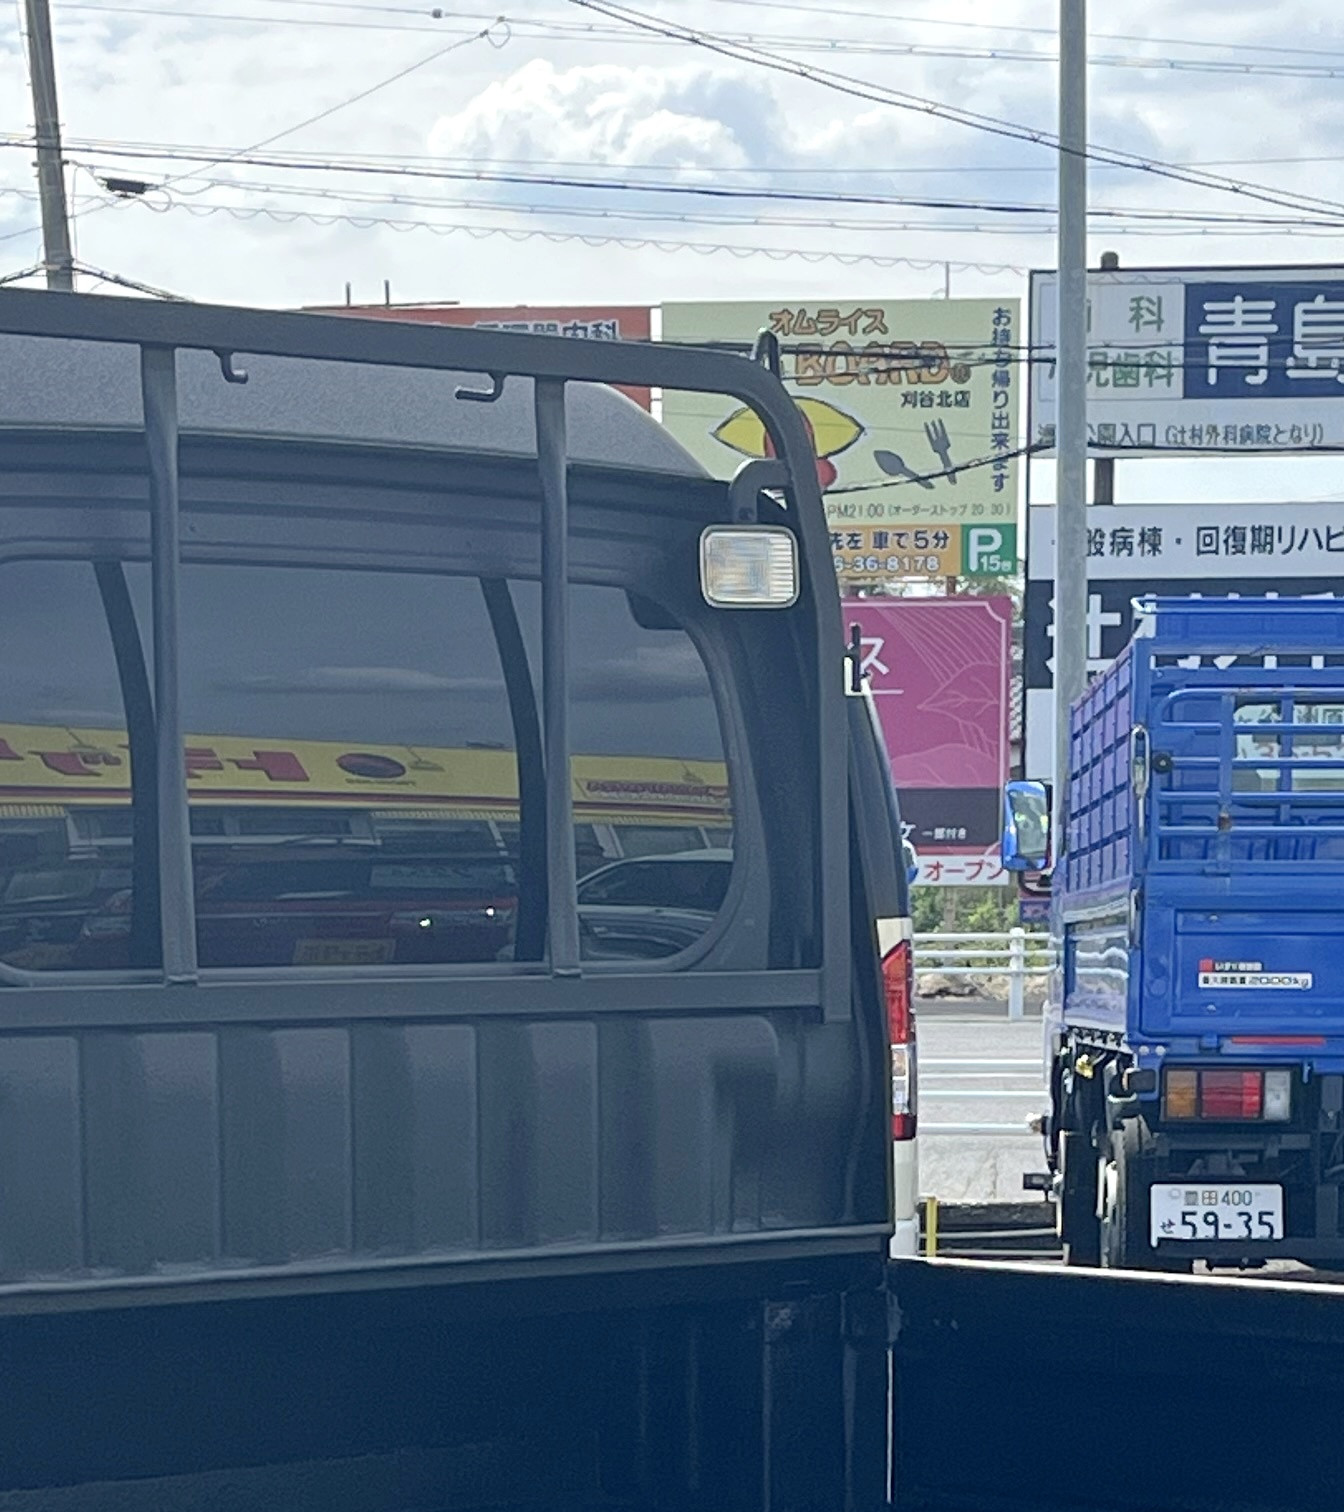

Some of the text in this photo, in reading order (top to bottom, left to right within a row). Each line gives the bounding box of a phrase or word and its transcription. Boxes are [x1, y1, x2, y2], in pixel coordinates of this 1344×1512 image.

[769, 308, 889, 336] オムライス
[1048, 350, 1175, 388] 児歯科
[900, 390, 971, 409] 刈谷北店
[872, 529, 949, 551] 車で5分
[1221, 1190, 1253, 1206] 400
[1180, 1210, 1275, 1239] 59-35
